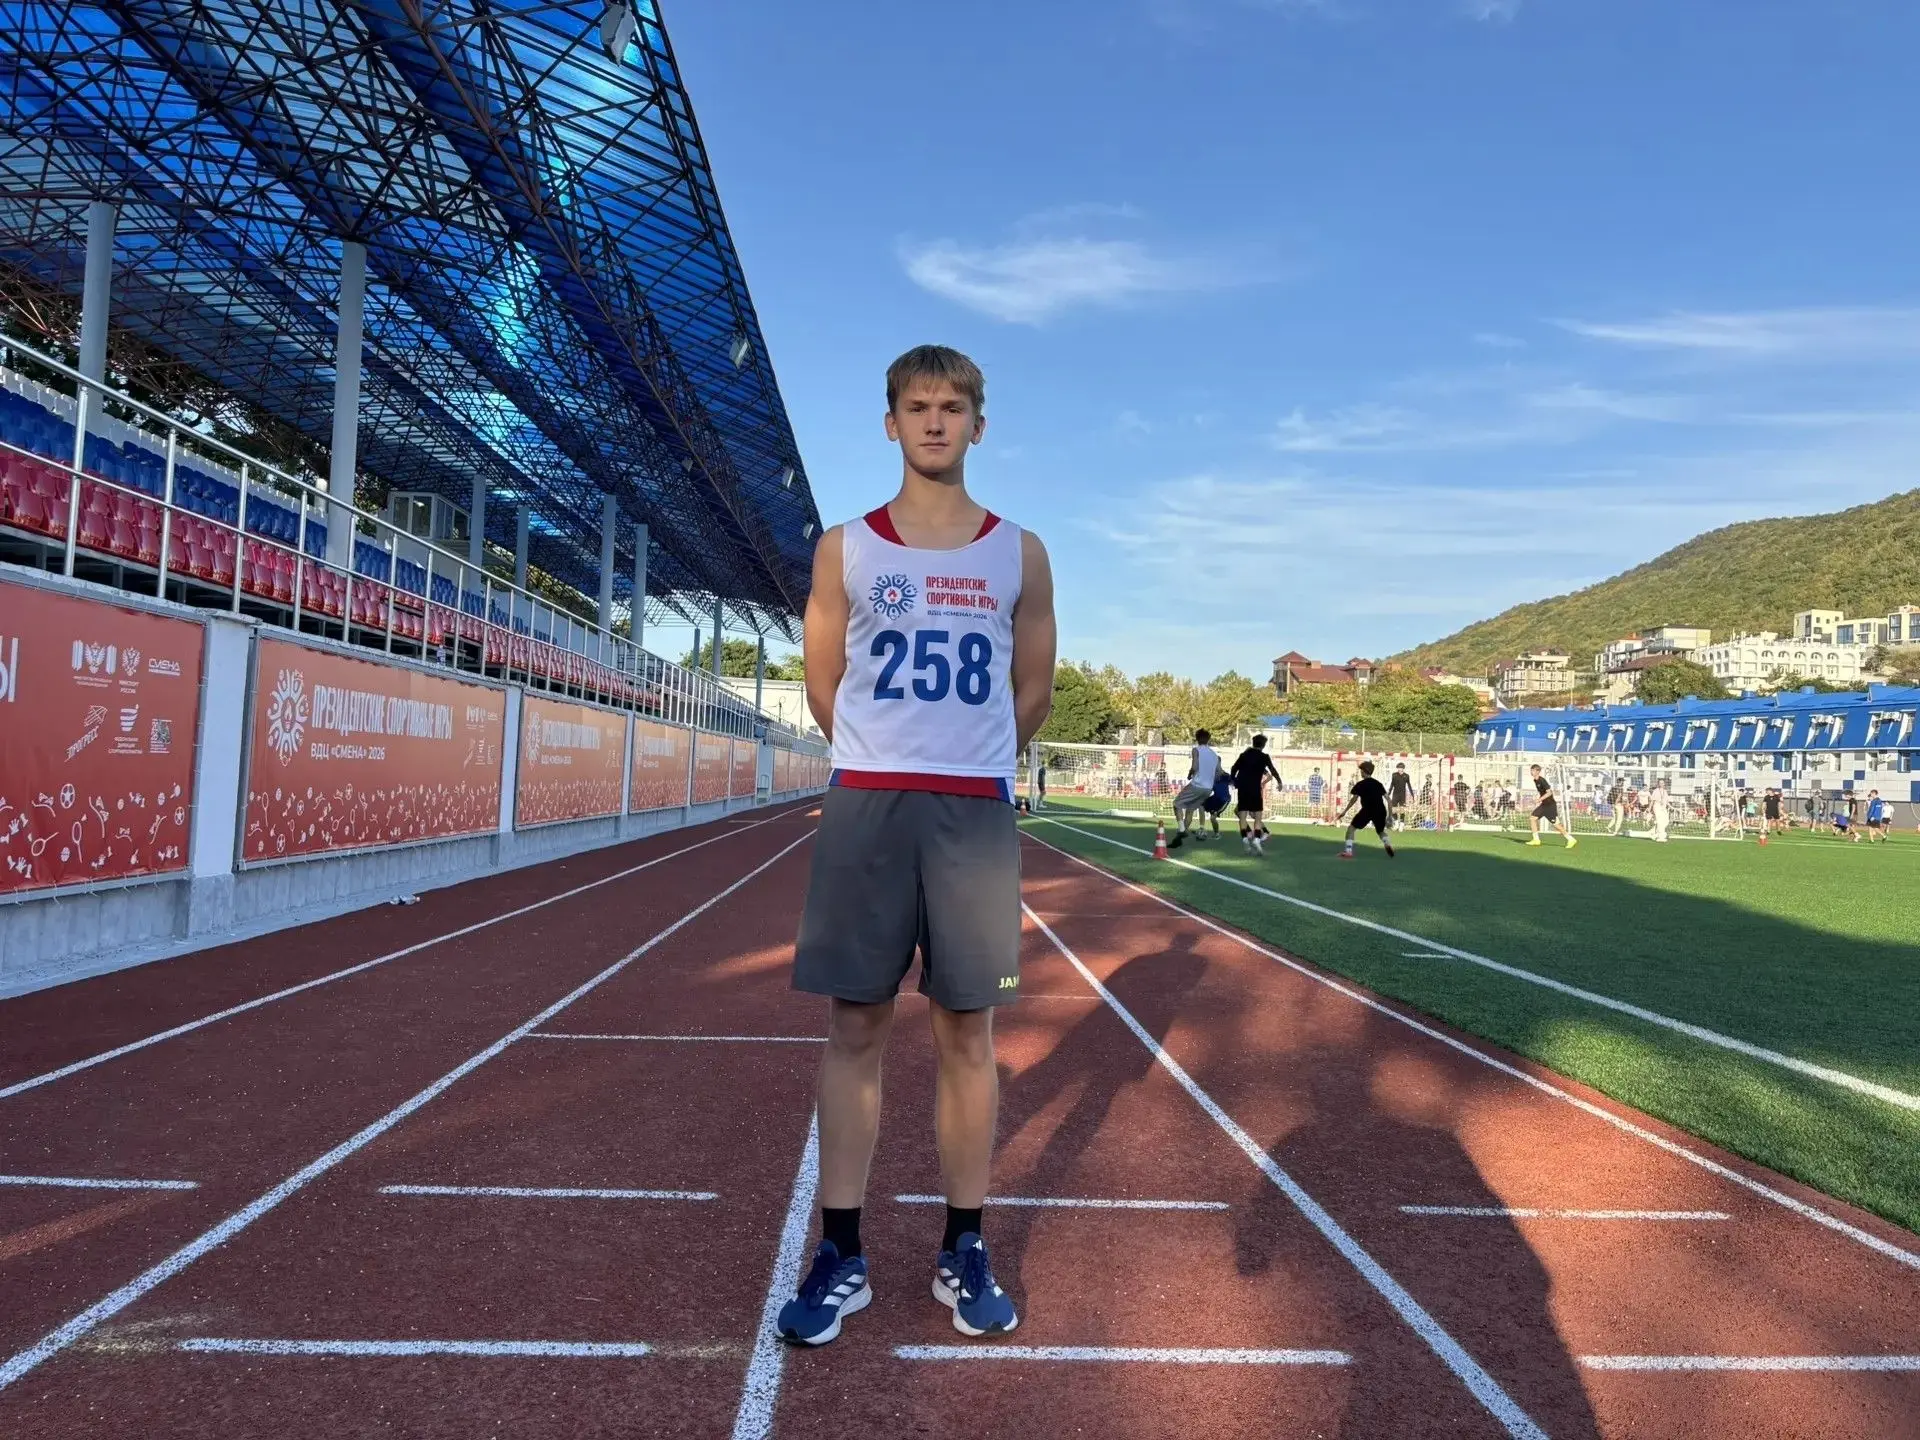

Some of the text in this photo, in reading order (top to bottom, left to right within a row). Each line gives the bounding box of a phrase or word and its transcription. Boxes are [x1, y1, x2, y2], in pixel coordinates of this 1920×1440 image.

[926, 576, 986, 591] ПРЕЗИДЕНТСКИЕ
[927, 592, 999, 611] СПОРТИВНЫЕ ИГРЫ
[870, 630, 993, 705] 258
[312, 684, 454, 739] ПРЕЗИДЕНТСКИЕ СПОРТИВНЫЕ ИГРЫ
[311, 743, 385, 760] ВДЦ «СМЕНА» 2026
